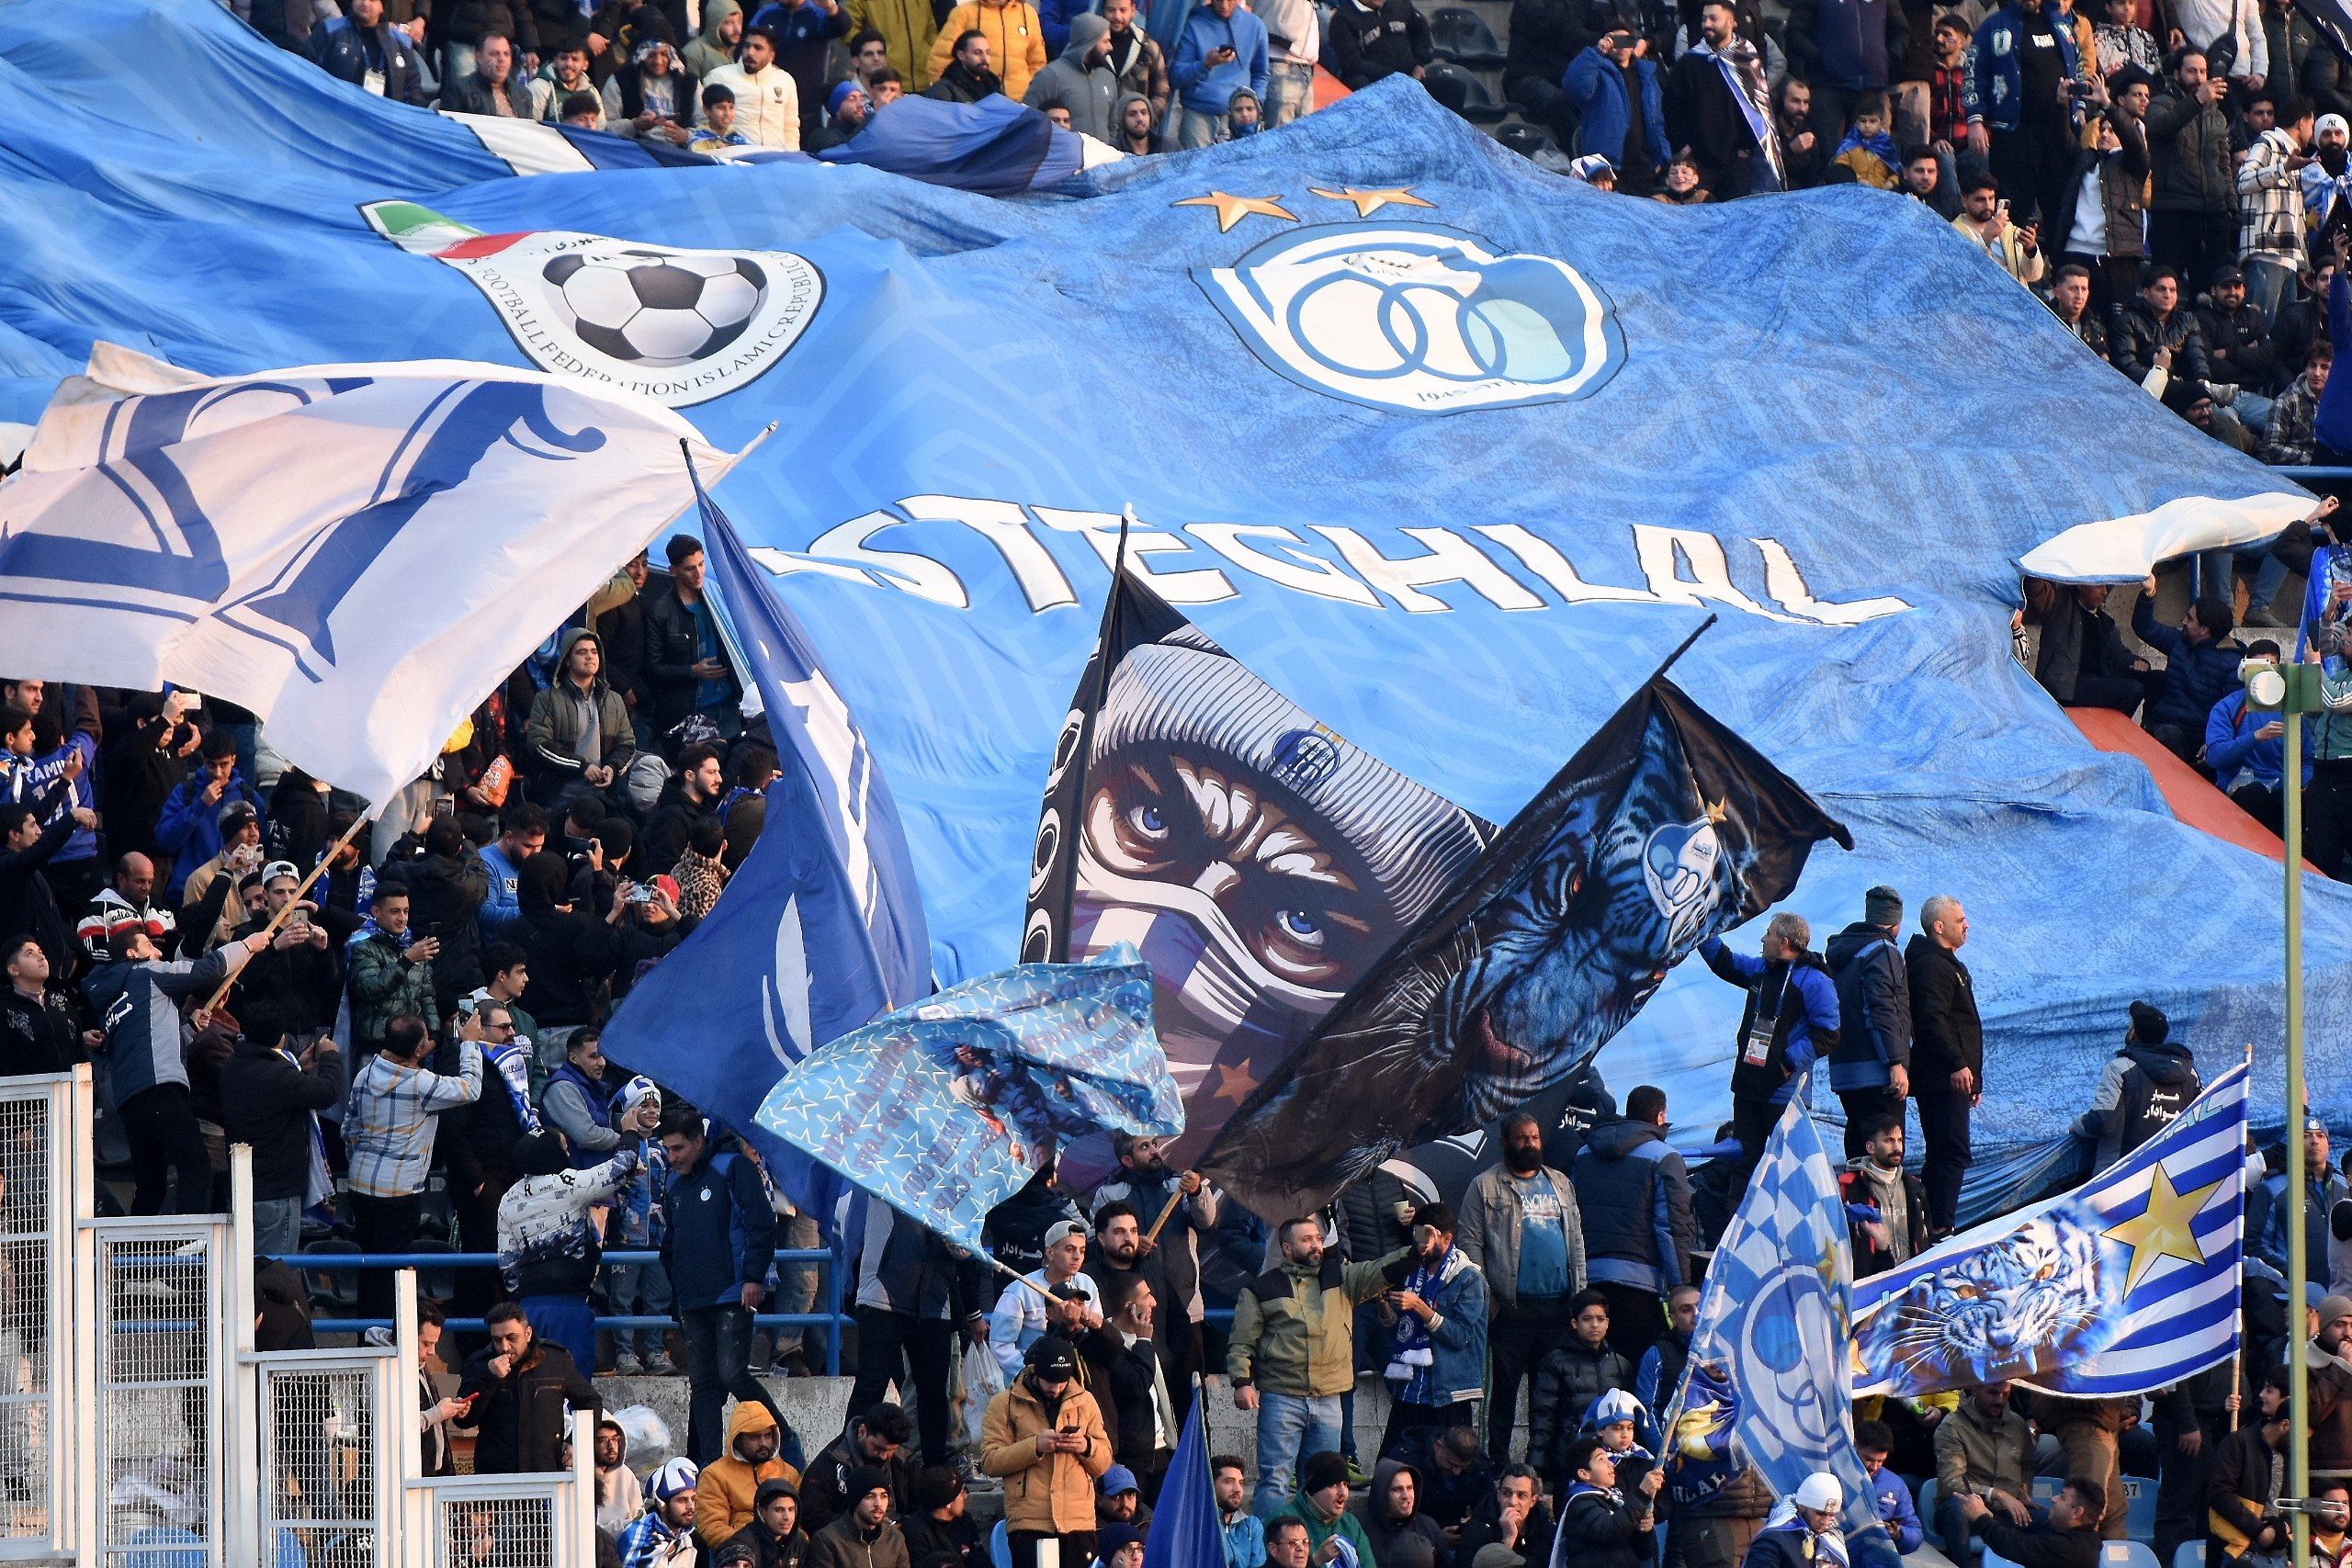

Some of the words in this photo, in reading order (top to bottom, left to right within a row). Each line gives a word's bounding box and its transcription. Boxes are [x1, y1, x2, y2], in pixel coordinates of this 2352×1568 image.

[476, 266, 545, 344] FOOTBALL
[695, 325, 787, 388] ISLAMIC
[777, 259, 812, 330] REPUBLIC
[2151, 1089, 2180, 1101] همیار
